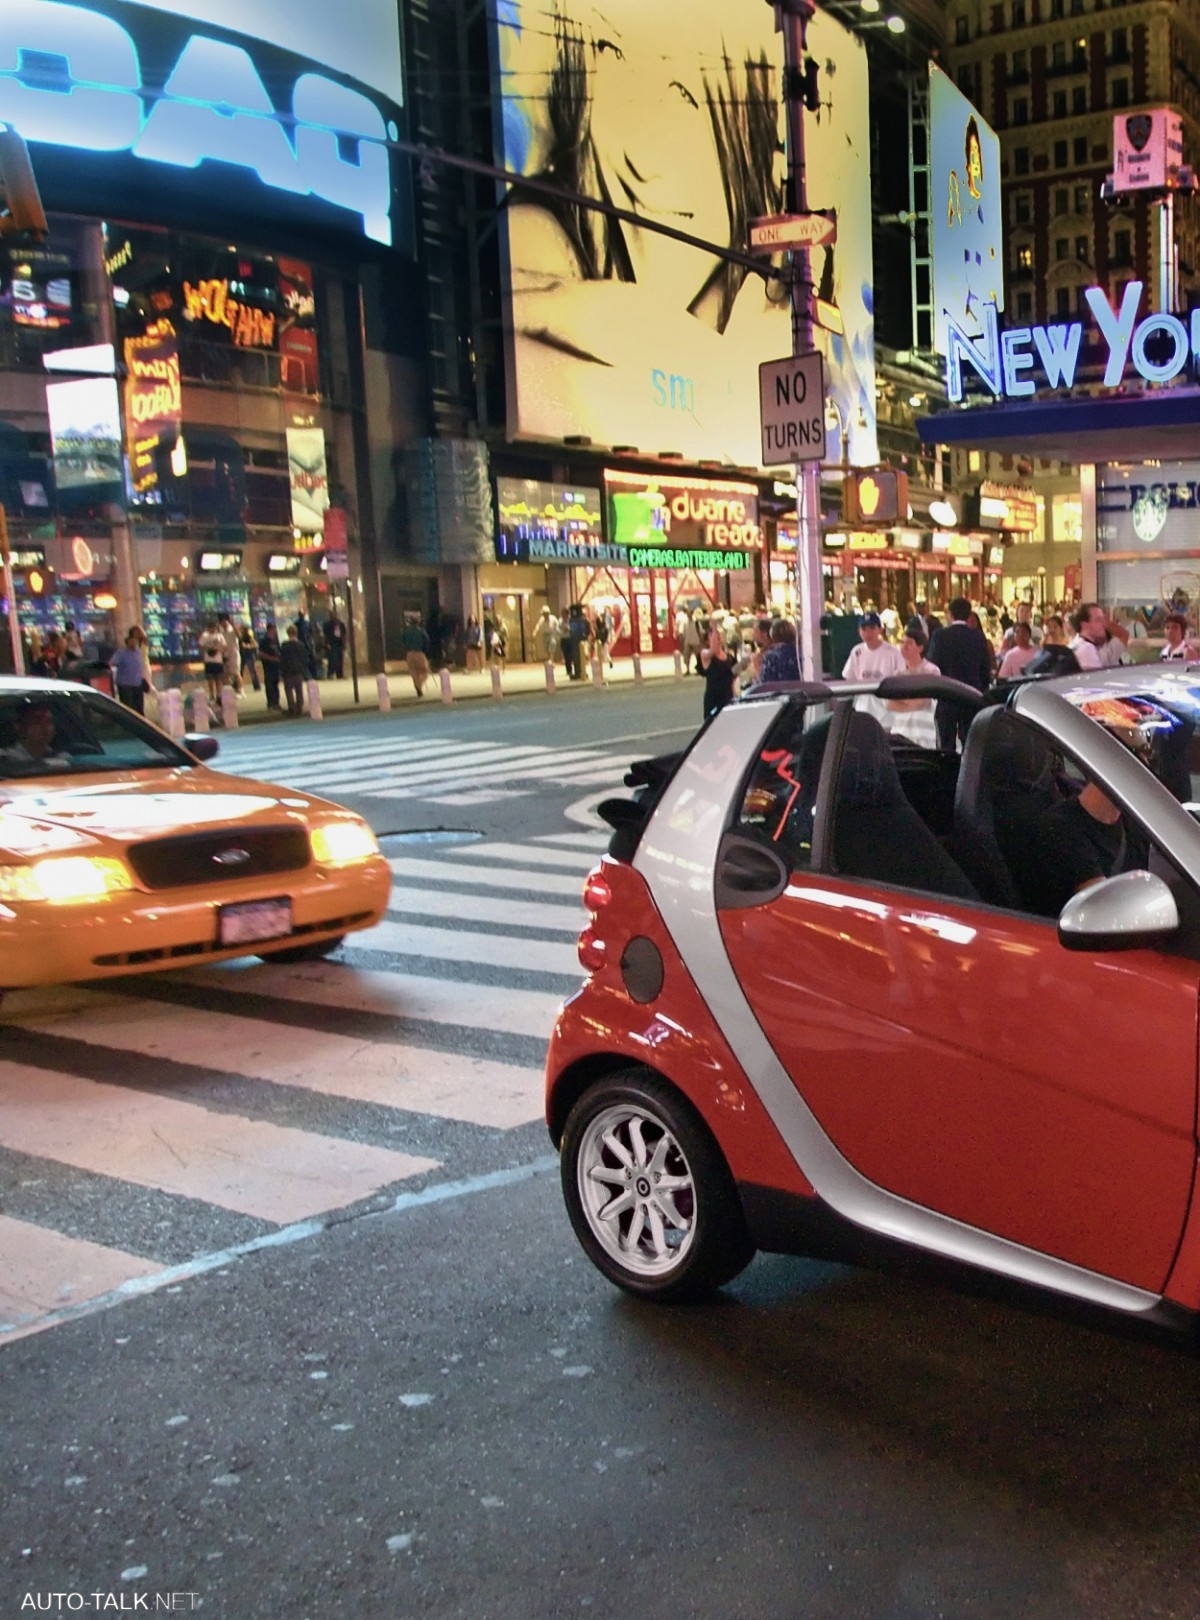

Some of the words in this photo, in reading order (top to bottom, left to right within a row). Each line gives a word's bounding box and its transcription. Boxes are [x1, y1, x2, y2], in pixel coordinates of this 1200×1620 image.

[758, 228, 782, 243] ONE
[800, 219, 825, 240] WAY
[943, 300, 1081, 402] NEW
[775, 370, 808, 407] NO
[764, 417, 822, 450] TURNS
[671, 491, 746, 524] duane
[528, 537, 628, 560] MARKETSITE
